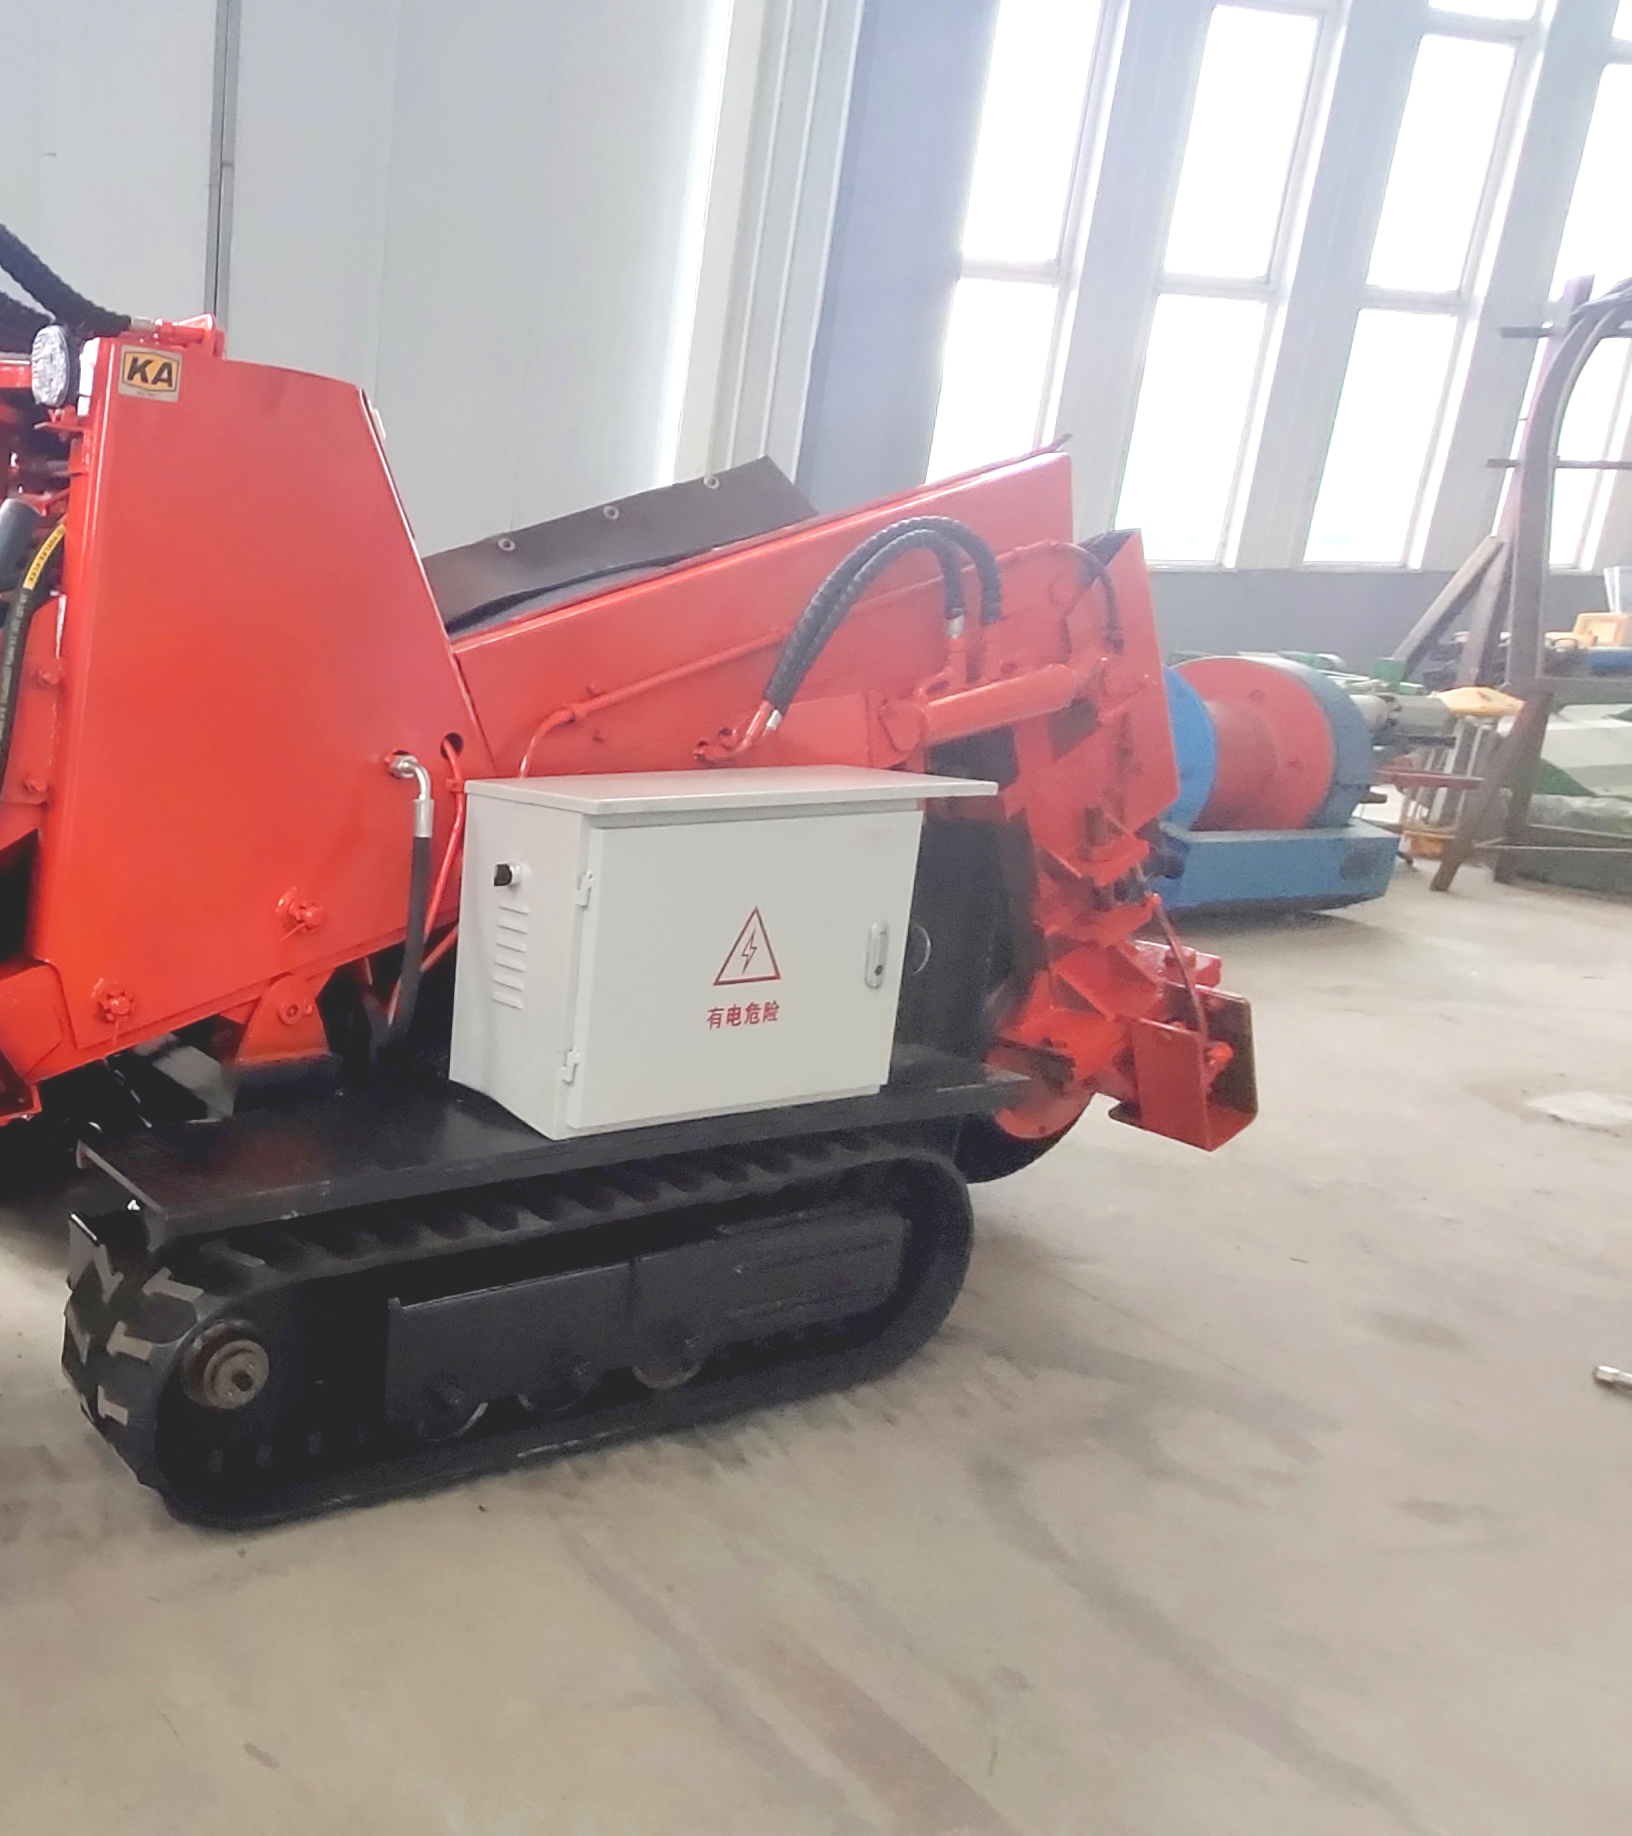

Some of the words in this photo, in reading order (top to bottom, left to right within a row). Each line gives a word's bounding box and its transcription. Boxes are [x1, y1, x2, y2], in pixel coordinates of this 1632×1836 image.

[127, 357, 173, 388] KA
[706, 1000, 780, 1030] 有电危险
